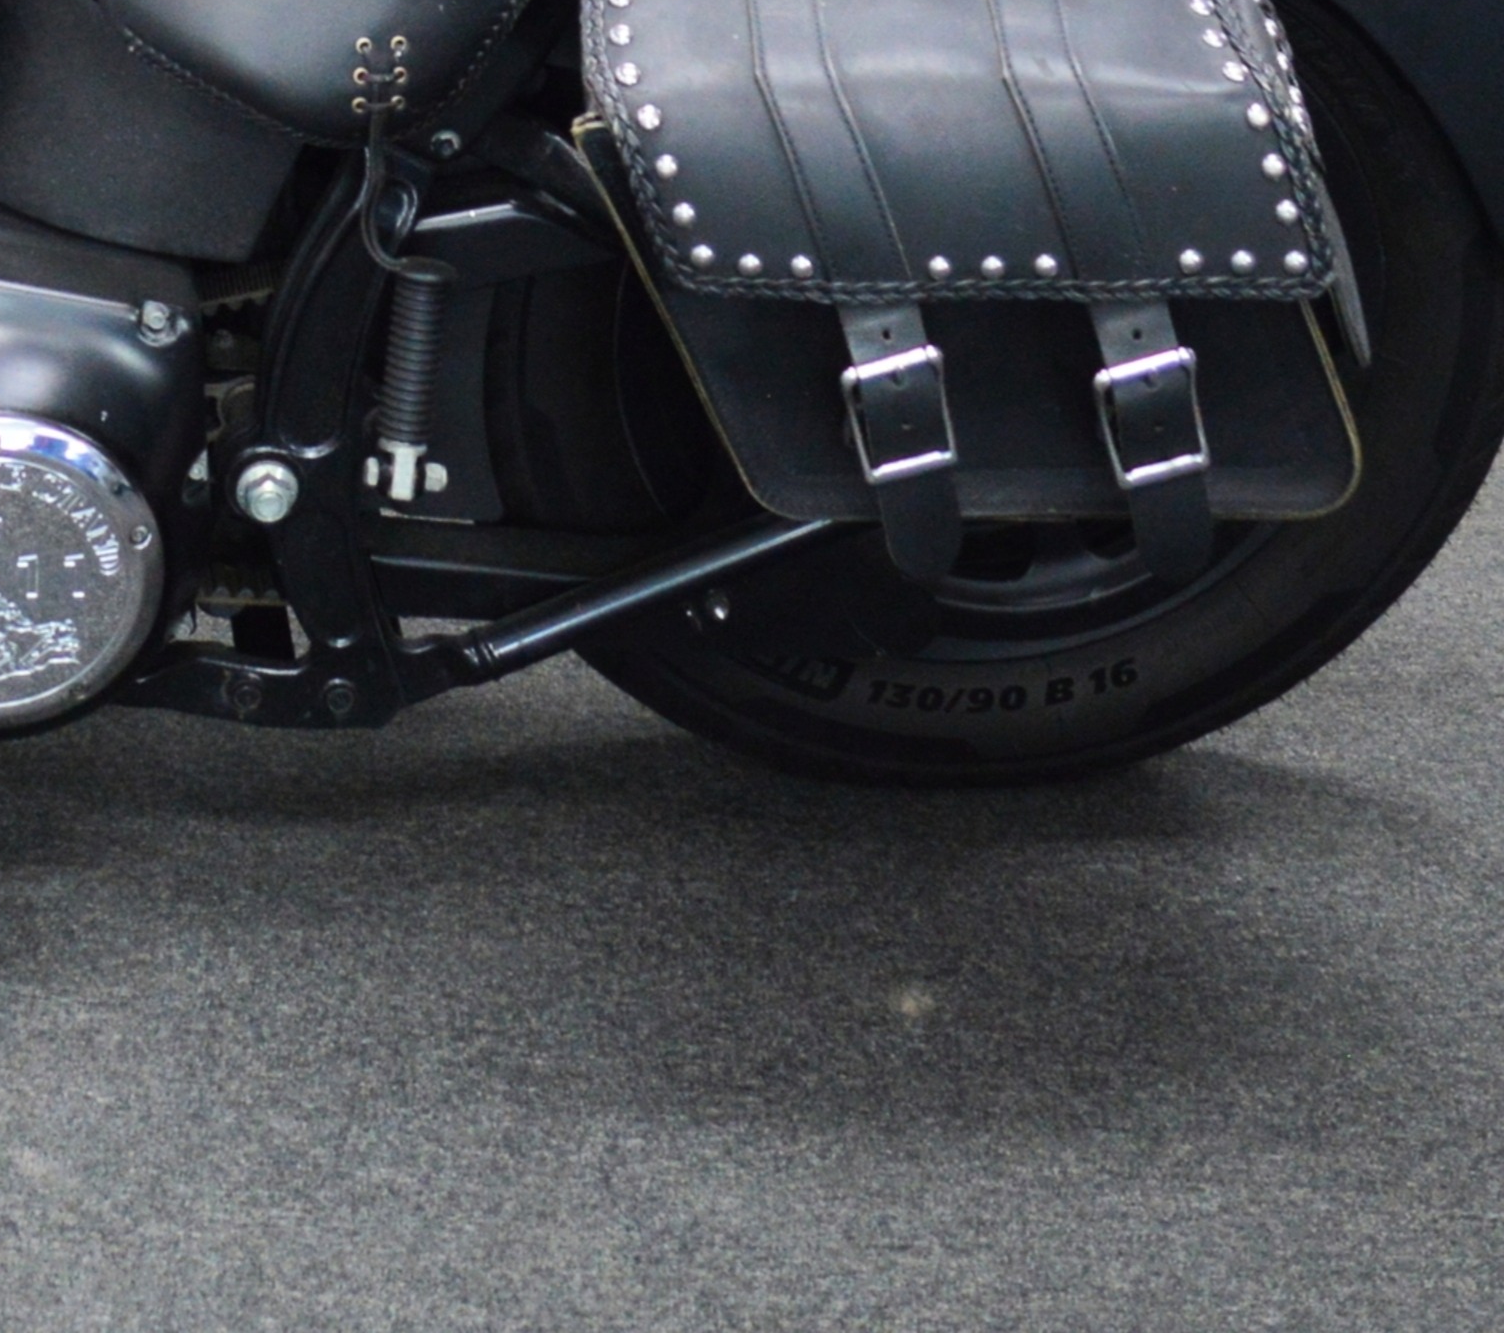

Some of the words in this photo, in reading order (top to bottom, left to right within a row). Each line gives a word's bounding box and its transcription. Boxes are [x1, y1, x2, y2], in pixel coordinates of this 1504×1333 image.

[866, 678, 1028, 715] 130/90
[1044, 674, 1076, 708] B
[1087, 656, 1140, 698] 16
